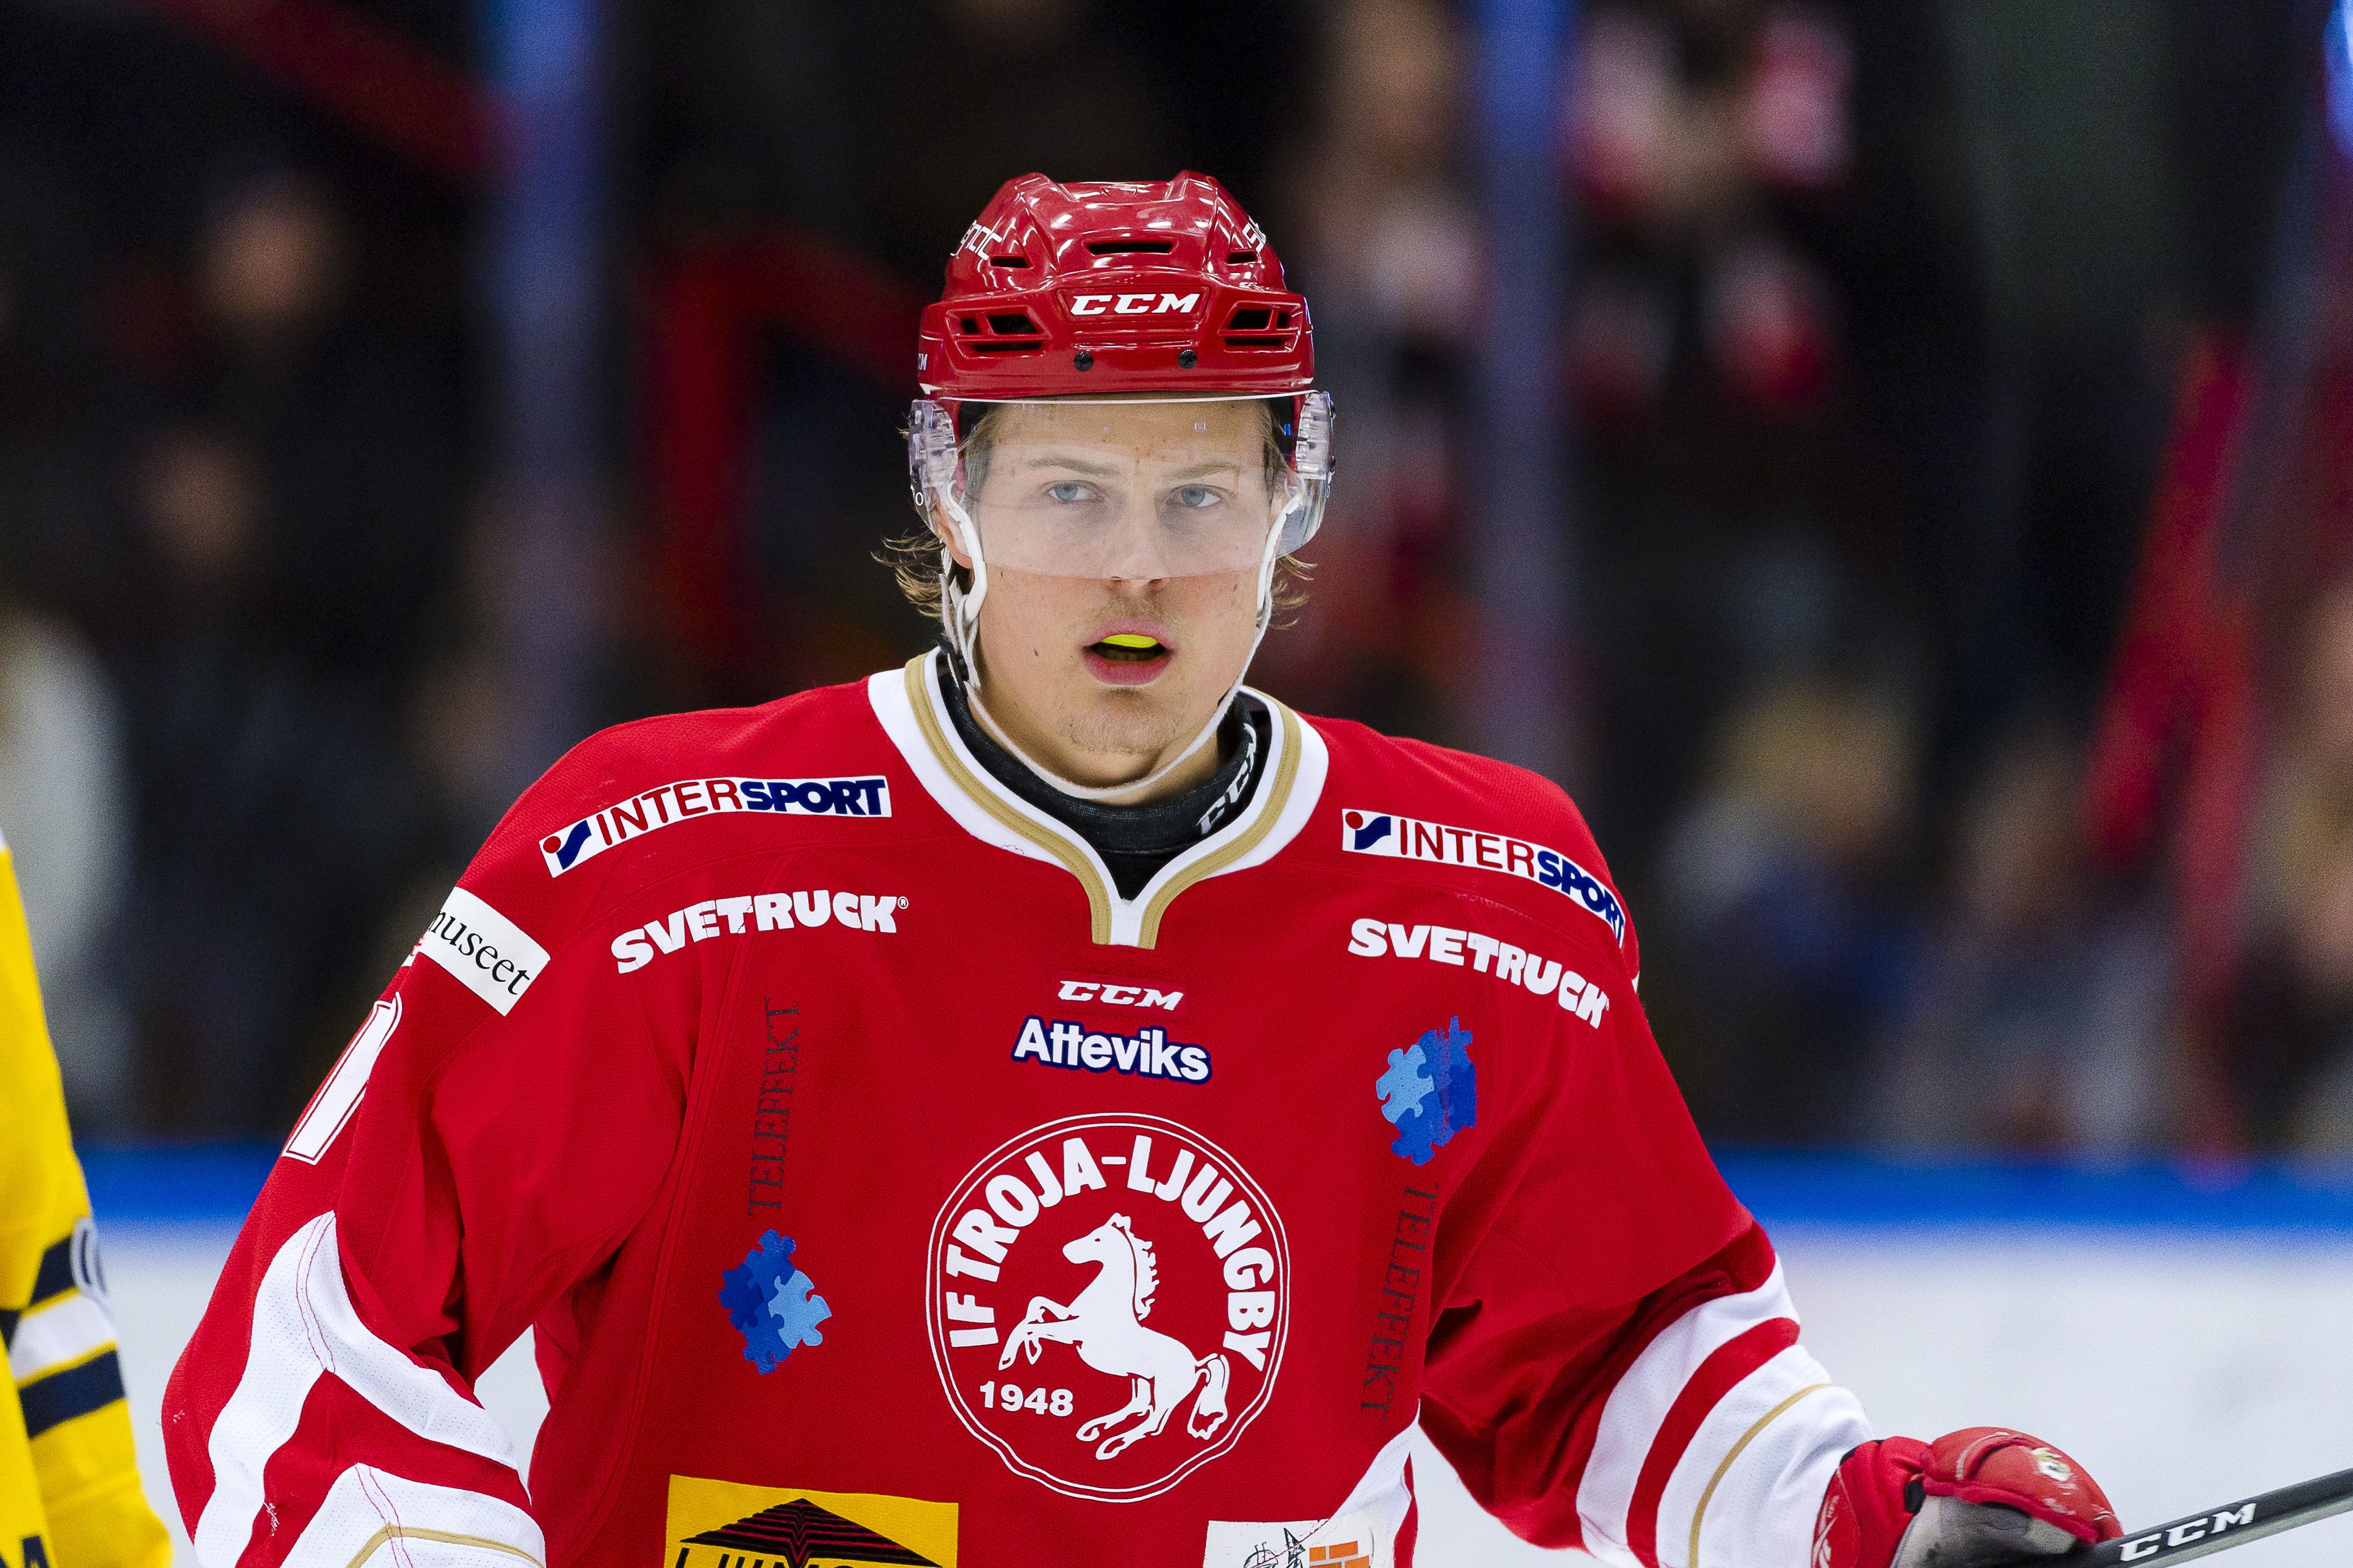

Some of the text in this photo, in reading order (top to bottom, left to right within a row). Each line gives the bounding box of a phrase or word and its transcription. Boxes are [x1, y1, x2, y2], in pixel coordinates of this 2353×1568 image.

[1070, 293, 1200, 316] CCM
[597, 779, 886, 846] INTERSPORT
[1400, 819, 1624, 945] INTERSPORT
[1058, 980, 1184, 1011] CCM
[1014, 1018, 1209, 1081] Atteviks
[747, 996, 799, 1216] TELEFFEKT
[946, 1135, 1275, 1372] IF TROJA-LJUNGBY
[1360, 1181, 1440, 1421] TELEFFEKT
[979, 1380, 1074, 1417] 1948
[2119, 1502, 2257, 1562] CCM
